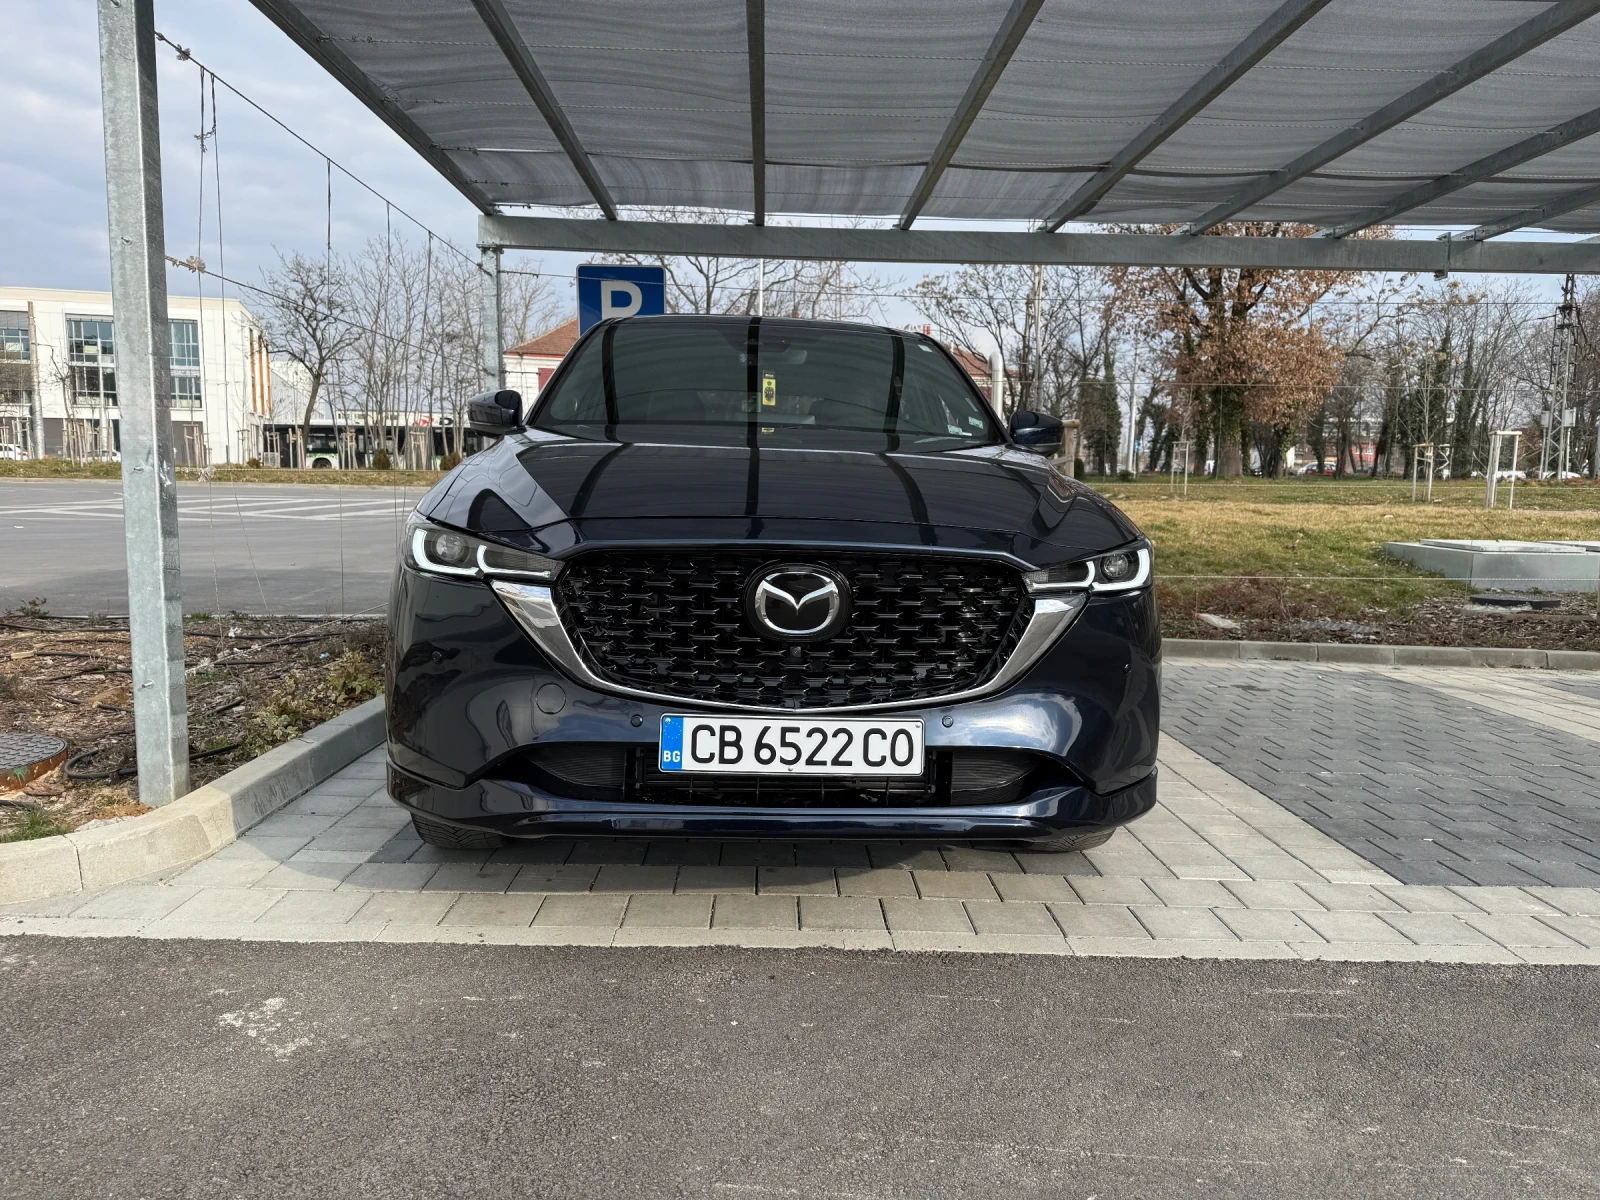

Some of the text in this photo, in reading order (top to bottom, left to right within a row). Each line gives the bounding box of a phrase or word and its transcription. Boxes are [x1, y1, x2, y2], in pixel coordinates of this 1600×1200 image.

[601, 280, 642, 320] P
[663, 750, 681, 763] BG
[690, 724, 914, 767] CB 6522 CO
